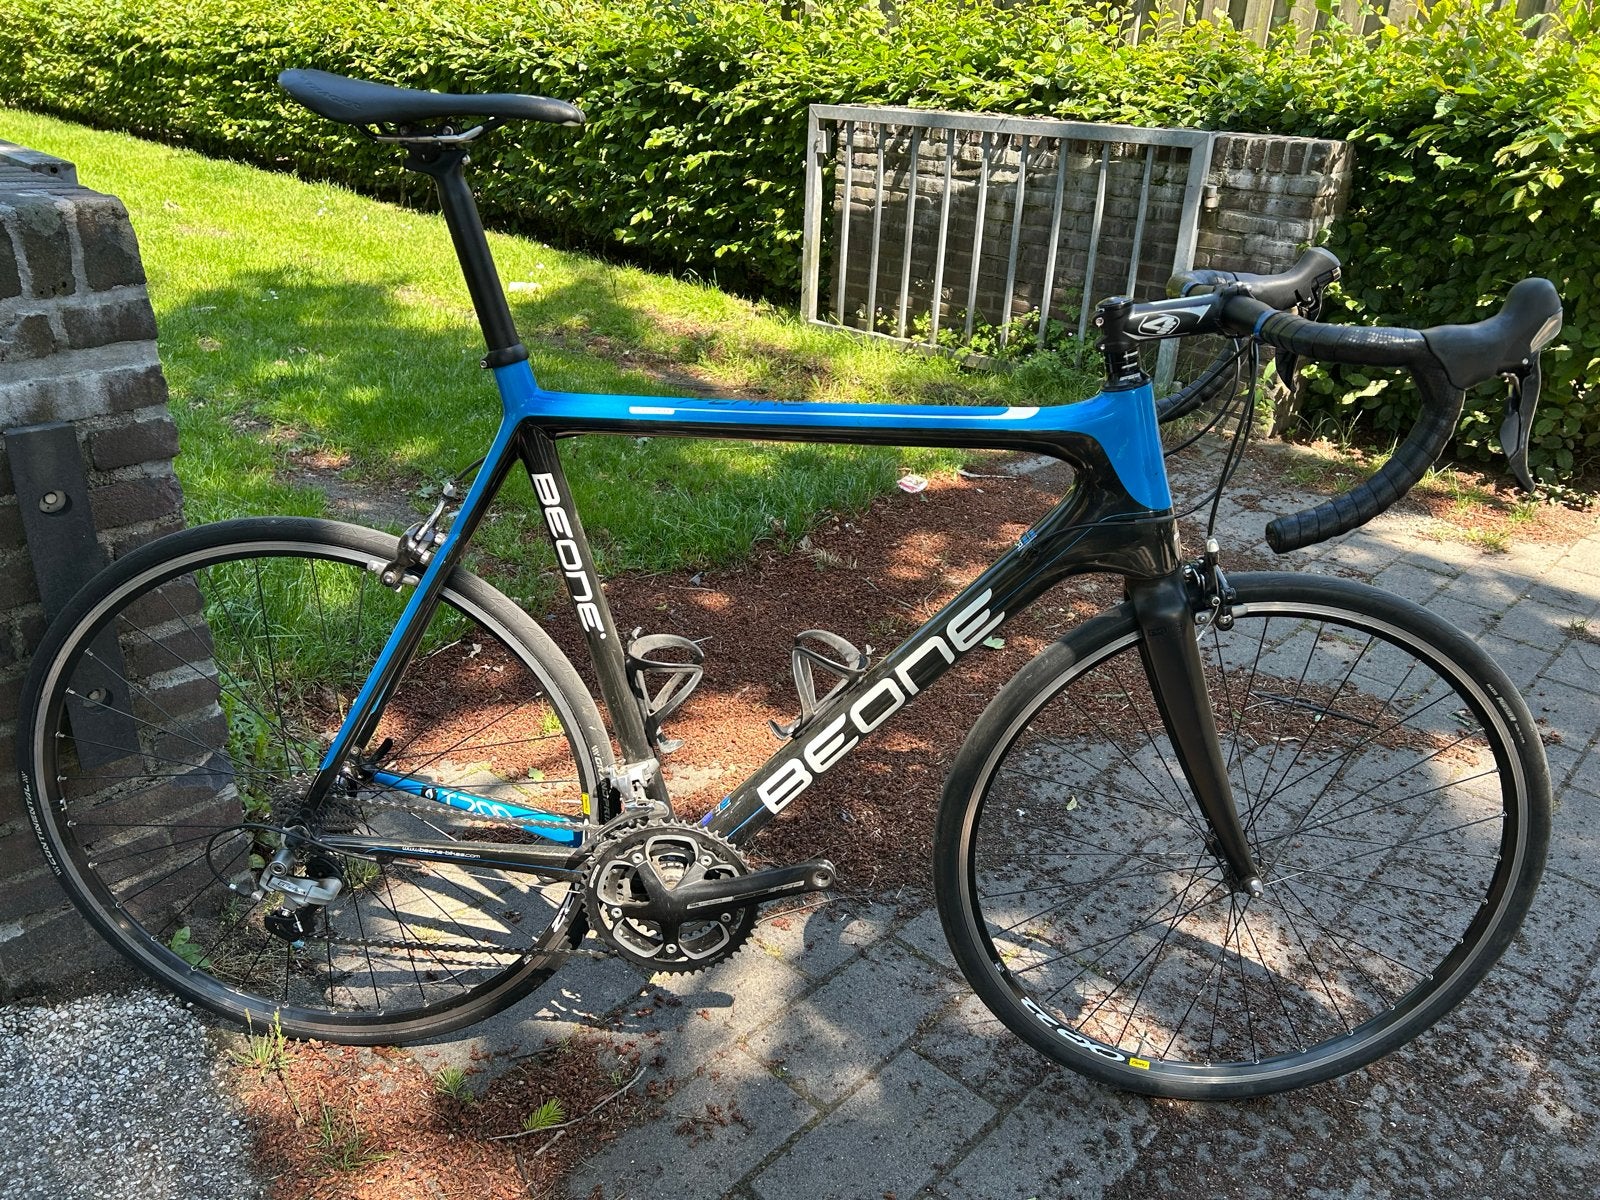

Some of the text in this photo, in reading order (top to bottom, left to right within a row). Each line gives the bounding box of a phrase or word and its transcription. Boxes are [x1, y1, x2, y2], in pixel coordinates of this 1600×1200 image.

[531, 472, 605, 633] BEONE
[756, 588, 1006, 815] BEONE
[23, 784, 57, 867] CONTINENTAL
[402, 845, 481, 858] www.beone-bikes.com
[1056, 1028, 1126, 1062] CXP
